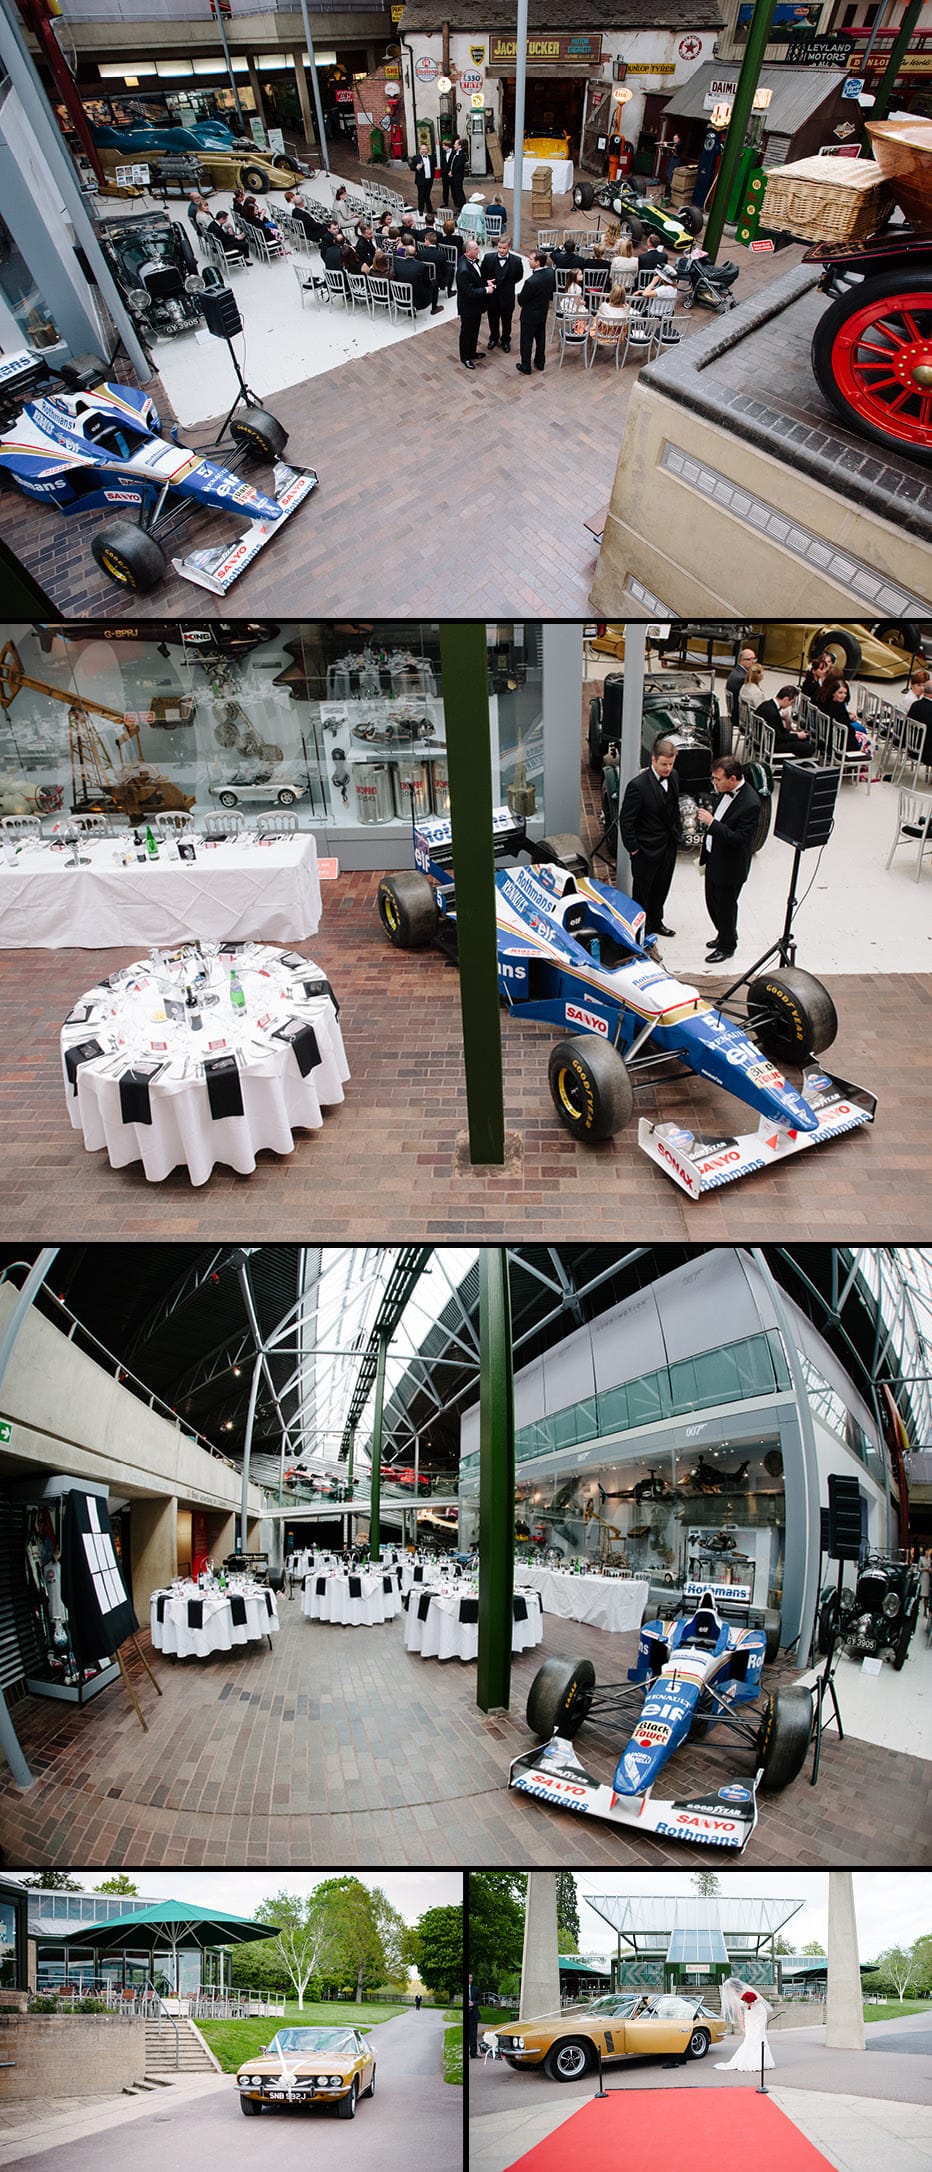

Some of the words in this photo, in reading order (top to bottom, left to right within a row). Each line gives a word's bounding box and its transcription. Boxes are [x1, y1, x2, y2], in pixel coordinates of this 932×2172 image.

[808, 44, 852, 52] LEYLAND
[808, 53, 846, 61] MOTORS
[107, 492, 140, 501] SANYO
[281, 479, 305, 505] SANYO
[285, 479, 317, 515] Rothmans
[217, 545, 247, 579] SANYO
[221, 543, 263, 589] Rothmans
[415, 848, 430, 872] elf
[436, 888, 443, 908] 5
[516, 870, 553, 912] Rothmans
[569, 916, 582, 926] elf
[537, 924, 556, 941] elf
[567, 1007, 607, 1033] SANYO
[766, 984, 804, 1041] GOODYEAR
[701, 1014, 725, 1033] 5
[726, 1041, 762, 1065] elf
[572, 1060, 594, 1129] GOODYEAR
[808, 1112, 871, 1144] Rothmans
[700, 1158, 766, 1191] Rothmans
[688, 1584, 747, 1598] Rothmans
[665, 1682, 682, 1693] 5
[645, 1694, 692, 1708] RENAULT
[640, 1704, 685, 1721] elf
[634, 1730, 667, 1744] Tower
[638, 1721, 669, 1736] Black
[514, 1778, 590, 1812] Rothmans
[531, 1775, 587, 1796] SANYO
[686, 1803, 742, 1816] GOODYEAR
[676, 1814, 735, 1832] SANYO
[655, 1822, 740, 1848] Rothmans
